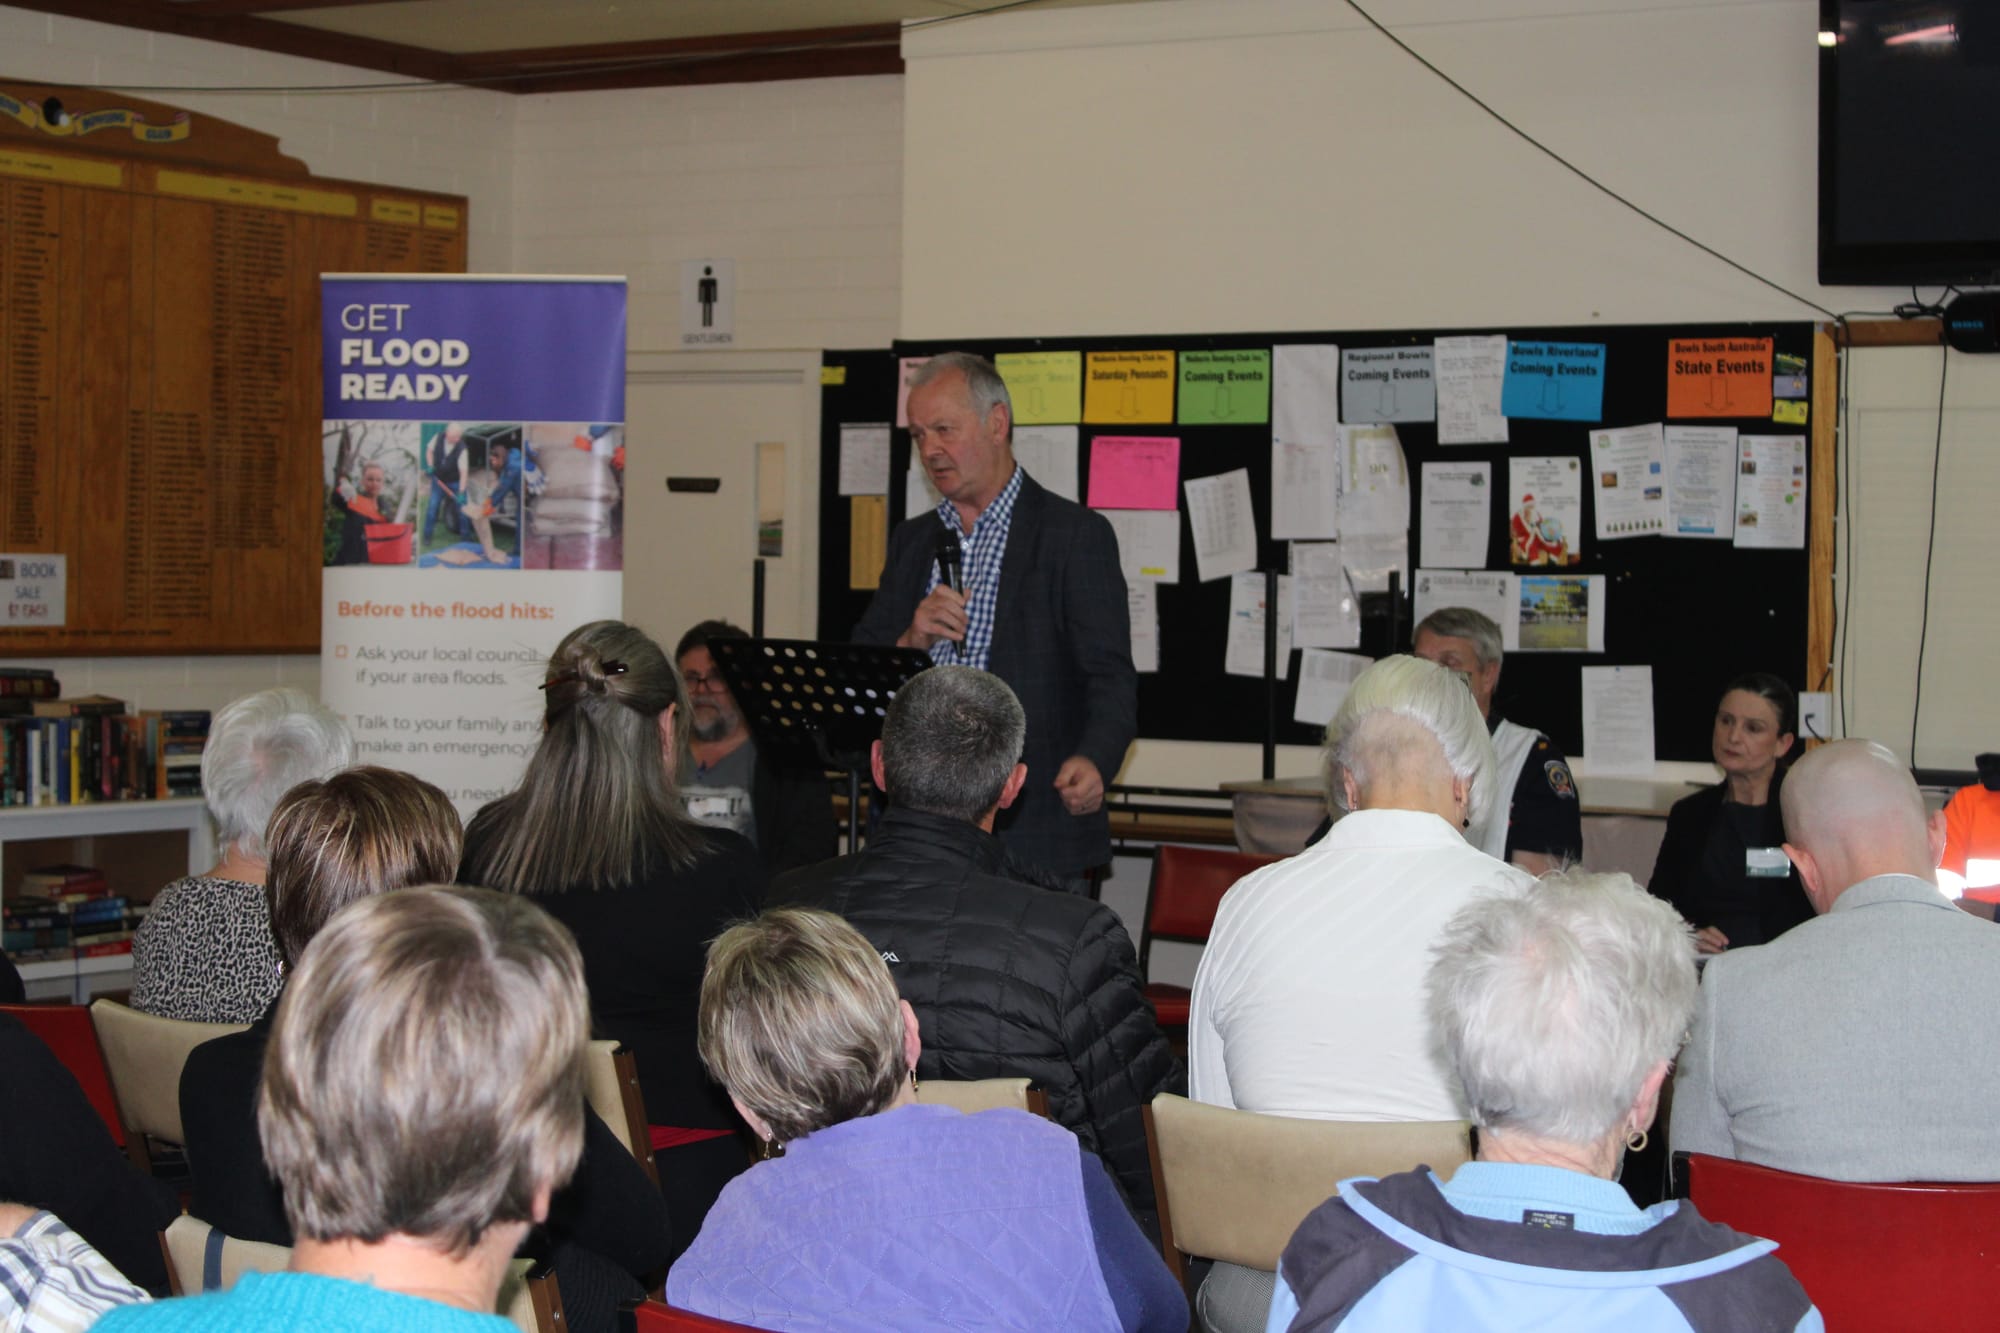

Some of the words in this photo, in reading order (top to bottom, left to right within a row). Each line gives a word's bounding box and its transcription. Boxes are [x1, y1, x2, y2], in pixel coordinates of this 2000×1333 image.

[341, 304, 410, 332] GET
[341, 339, 470, 367] FLOOD
[1512, 345, 1543, 356] Bowls
[1547, 345, 1600, 358] Riverland
[1675, 343, 1700, 353] Bowls
[1702, 342, 1726, 353] South
[1728, 341, 1766, 352] Australia
[1347, 352, 1395, 364] Regional
[1398, 351, 1431, 360] Bowls
[1347, 368, 1390, 383] Coming
[1393, 367, 1431, 380] Events
[1510, 361, 1554, 377] Coming
[1557, 362, 1598, 376] Events
[1675, 359, 1713, 375] State
[1716, 359, 1766, 374] Events
[1092, 368, 1127, 383] Saturday
[1130, 368, 1168, 380] Pennants
[1184, 370, 1225, 385] Coming
[1228, 369, 1264, 381] Events
[340, 373, 469, 402] READY
[20, 562, 57, 578] BOOK
[15, 585, 42, 600] SALE
[337, 601, 404, 618] Before
[410, 602, 446, 619] the
[452, 602, 504, 619] flood
[511, 603, 554, 620] hits:
[356, 646, 387, 662] Ask
[391, 649, 429, 666] your
[433, 646, 473, 662] local
[476, 647, 539, 663] council
[356, 668, 369, 684] if
[370, 672, 407, 689] your
[412, 672, 449, 685] area
[453, 669, 508, 686] floods.
[355, 714, 389, 730] Talk
[393, 716, 410, 730] to
[415, 719, 453, 734] your
[457, 715, 508, 735] family
[356, 738, 402, 753] make
[407, 741, 428, 753] an
[433, 742, 529, 758] emergency
